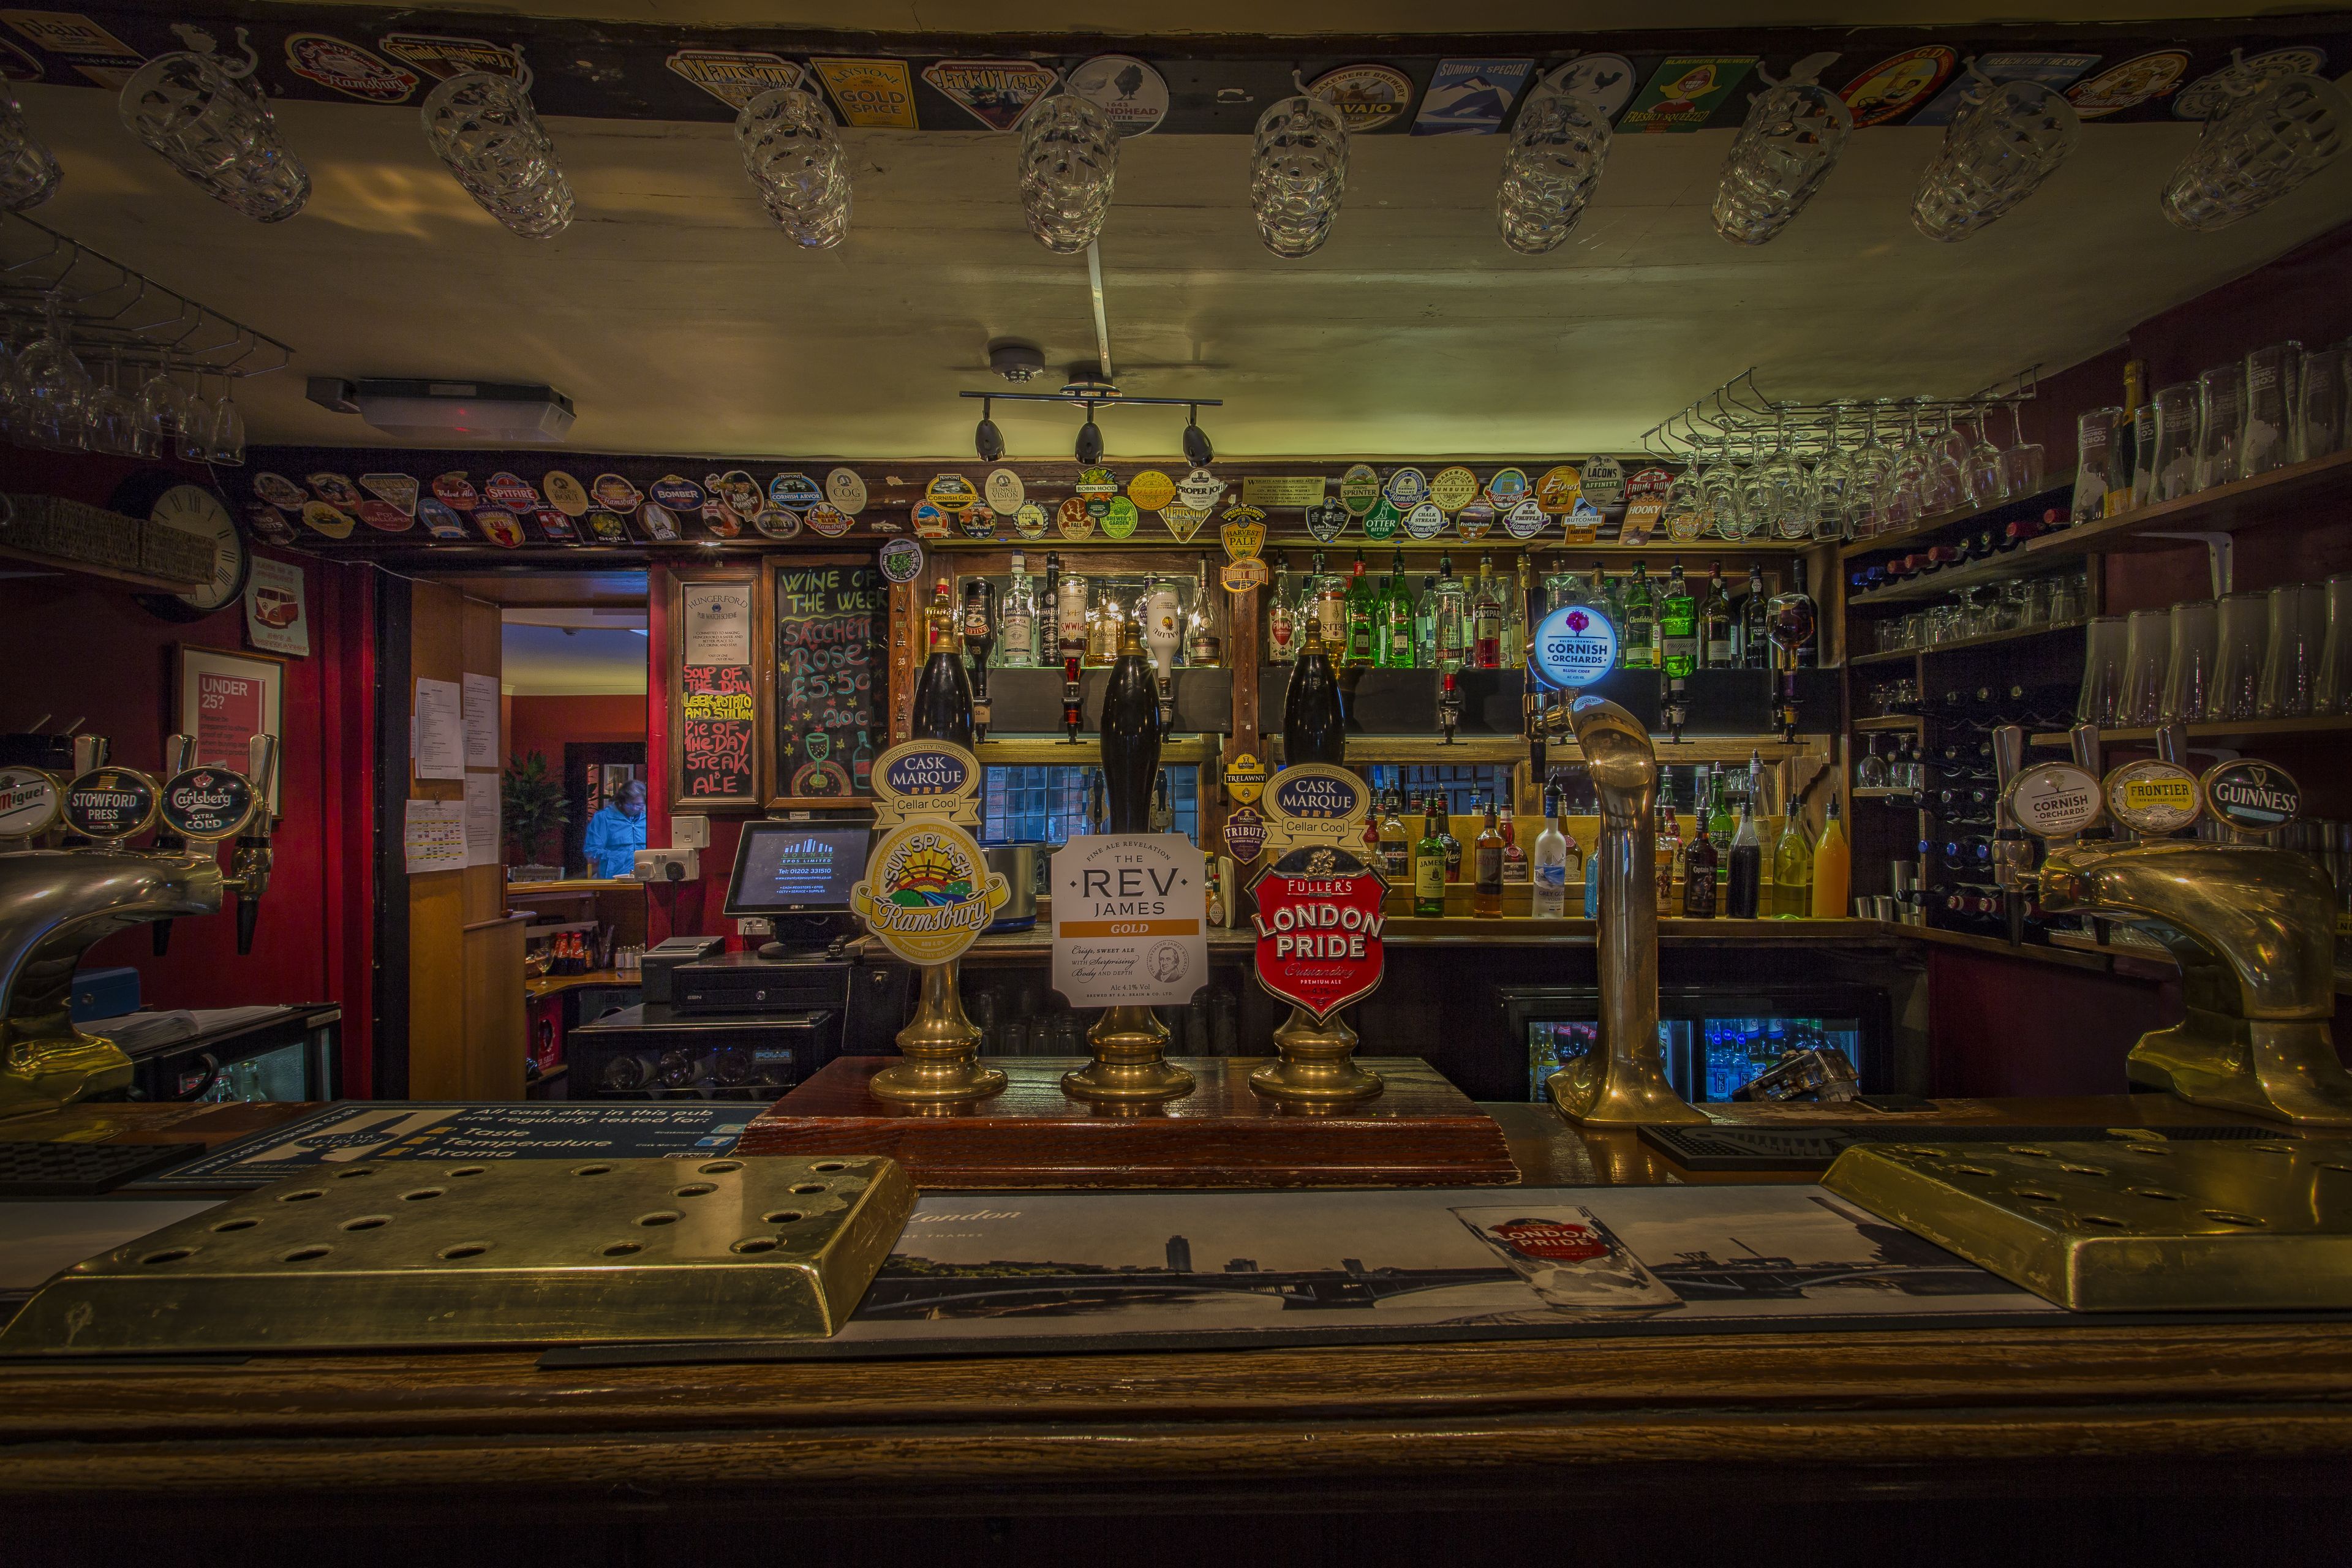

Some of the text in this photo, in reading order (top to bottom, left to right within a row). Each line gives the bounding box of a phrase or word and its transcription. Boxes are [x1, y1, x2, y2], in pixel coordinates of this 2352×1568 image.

[680, 59, 795, 85] Mansion
[831, 67, 902, 86] KEYSTONE
[1439, 63, 1528, 77] SUMMIT SPECIAL
[318, 70, 409, 92] Ramsbury
[839, 89, 906, 104] GOLD
[852, 104, 903, 115] SPICE
[1624, 110, 1711, 123] FRESHLY SQUEEZED
[1587, 468, 1618, 479] LACONS
[490, 489, 535, 499] SPITFIRE
[657, 490, 699, 499] BOMBER
[833, 488, 861, 498] COG
[1628, 505, 1661, 515] HOOKY
[1509, 522, 1542, 532] Ramsbury
[1229, 537, 1257, 546] PALE
[688, 595, 748, 609] HUNGERFORD
[1061, 622, 1084, 633] PIMM'S
[1272, 622, 1292, 631] PIMM'S
[1547, 643, 1608, 655] CORNISH
[1552, 655, 1602, 663] ORCHARDS
[683, 665, 743, 680] SOUP OF
[202, 677, 248, 696] UNDER
[201, 693, 225, 710] 25?
[884, 744, 968, 764] INDEPENDENTLY INSPECTED
[904, 756, 947, 770] CASK
[693, 773, 737, 795] ALE
[892, 770, 962, 786] MARQUE
[1276, 768, 1358, 786] INDEPENDENTLY INSPECTED
[1294, 780, 1337, 794] CASK
[2130, 784, 2190, 796] FRONTIER
[72, 793, 138, 808] STOWFORD
[173, 788, 232, 812] Carlsberg
[897, 797, 957, 810] Cellar Cool
[1282, 794, 1352, 809] MARQUE
[2034, 794, 2089, 812] CORNISH
[2216, 783, 2297, 813] GUINNESS
[88, 808, 119, 820] PRESS
[2039, 807, 2085, 820] ORCHARDS
[185, 819, 222, 829] COLD
[1286, 821, 1346, 833] Cellar Cool
[1225, 826, 1267, 840] TRIBUTE
[1087, 841, 1171, 862] FINE ALE REVELATION
[1082, 867, 1179, 898] REV
[1288, 879, 1352, 892] FULLER'S
[871, 898, 989, 932] Ramsbury
[1094, 902, 1165, 918] JAMES
[1255, 902, 1387, 940] LONDON
[1110, 924, 1149, 933] GOLD
[1276, 934, 1366, 960] PRIDE
[1089, 954, 1140, 970] Surprising
[462, 1128, 531, 1137] Taste
[442, 1137, 613, 1148] Temperature
[417, 1147, 518, 1157] Aroma
[1498, 1230, 1600, 1241] LONDON
